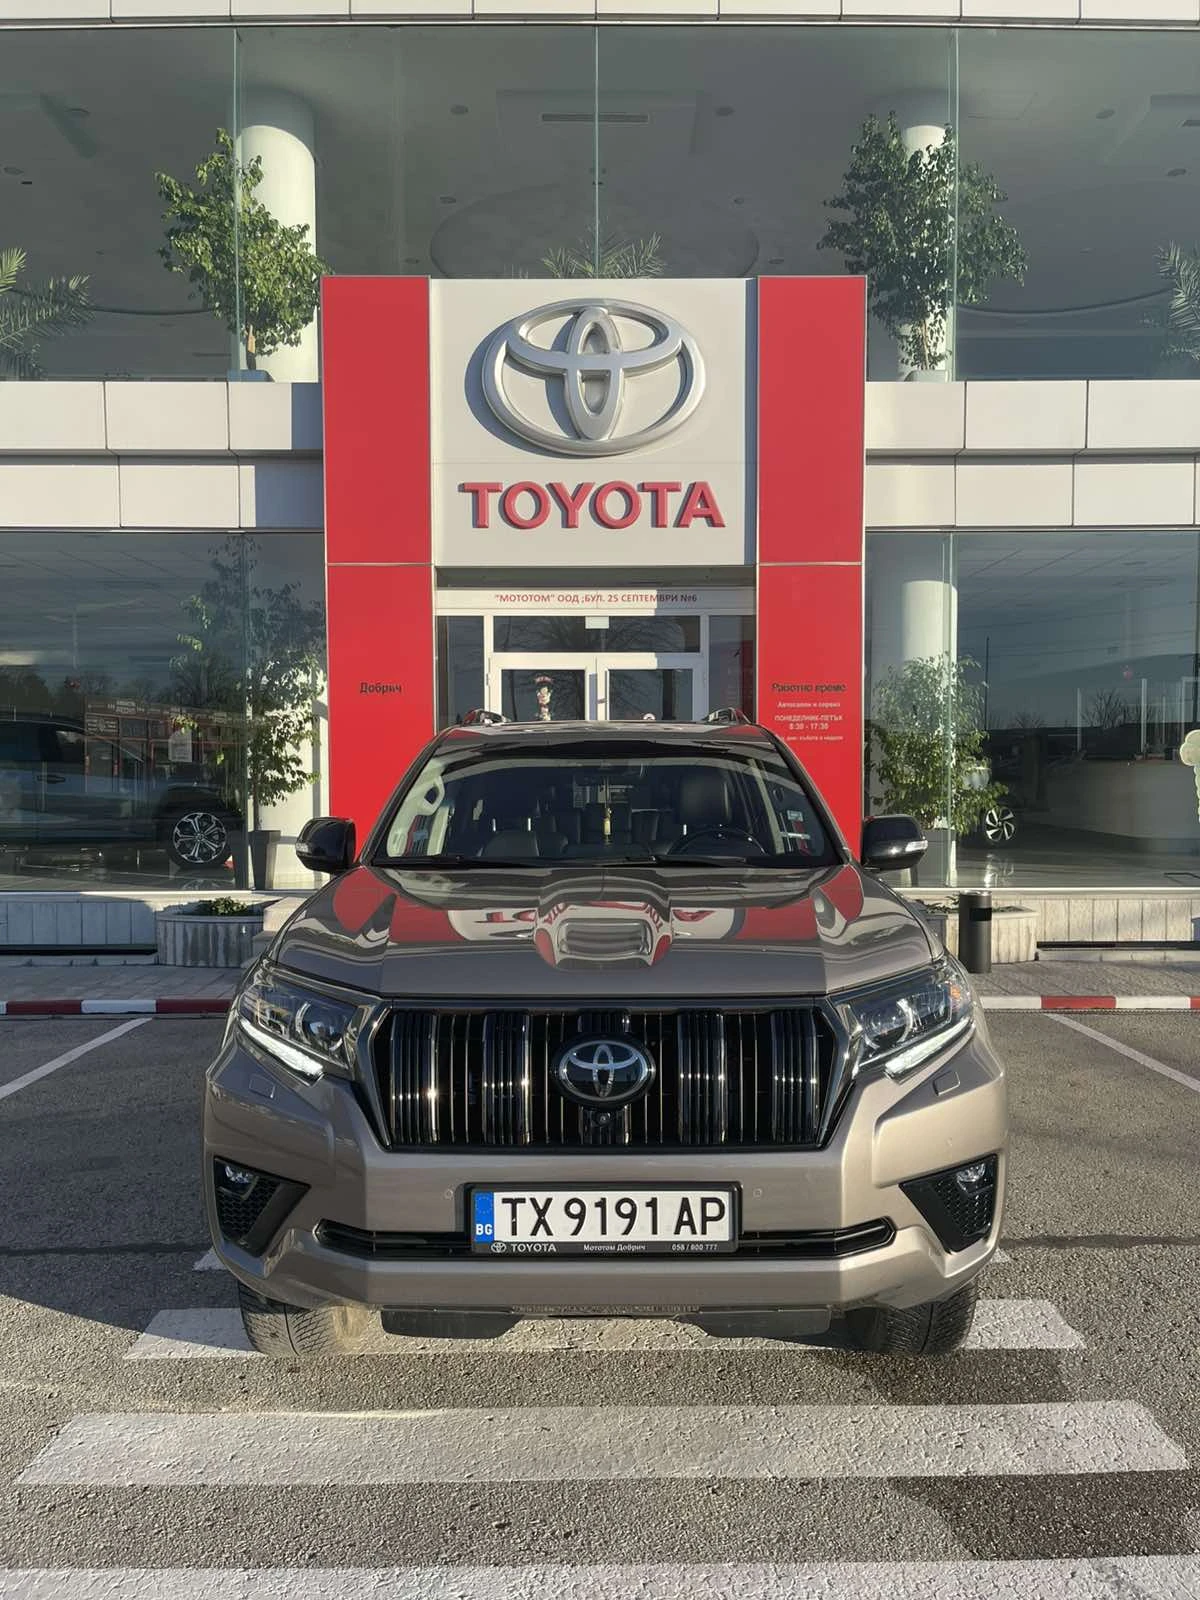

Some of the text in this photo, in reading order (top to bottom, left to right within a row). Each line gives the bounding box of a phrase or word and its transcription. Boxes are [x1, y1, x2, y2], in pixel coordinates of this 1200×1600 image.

[458, 480, 726, 529] TOYOTA
[558, 594, 579, 604] ООД
[608, 594, 619, 603] 25
[621, 594, 678, 603] СЕПТЕМВРИ
[360, 682, 402, 695] Добрич
[501, 1197, 726, 1236] TX 9191 AP
[475, 1223, 493, 1236] BG
[511, 1243, 557, 1253] TOYOTA
[583, 1243, 646, 1253] Мототом Добрич
[705, 1243, 718, 1251] 777
